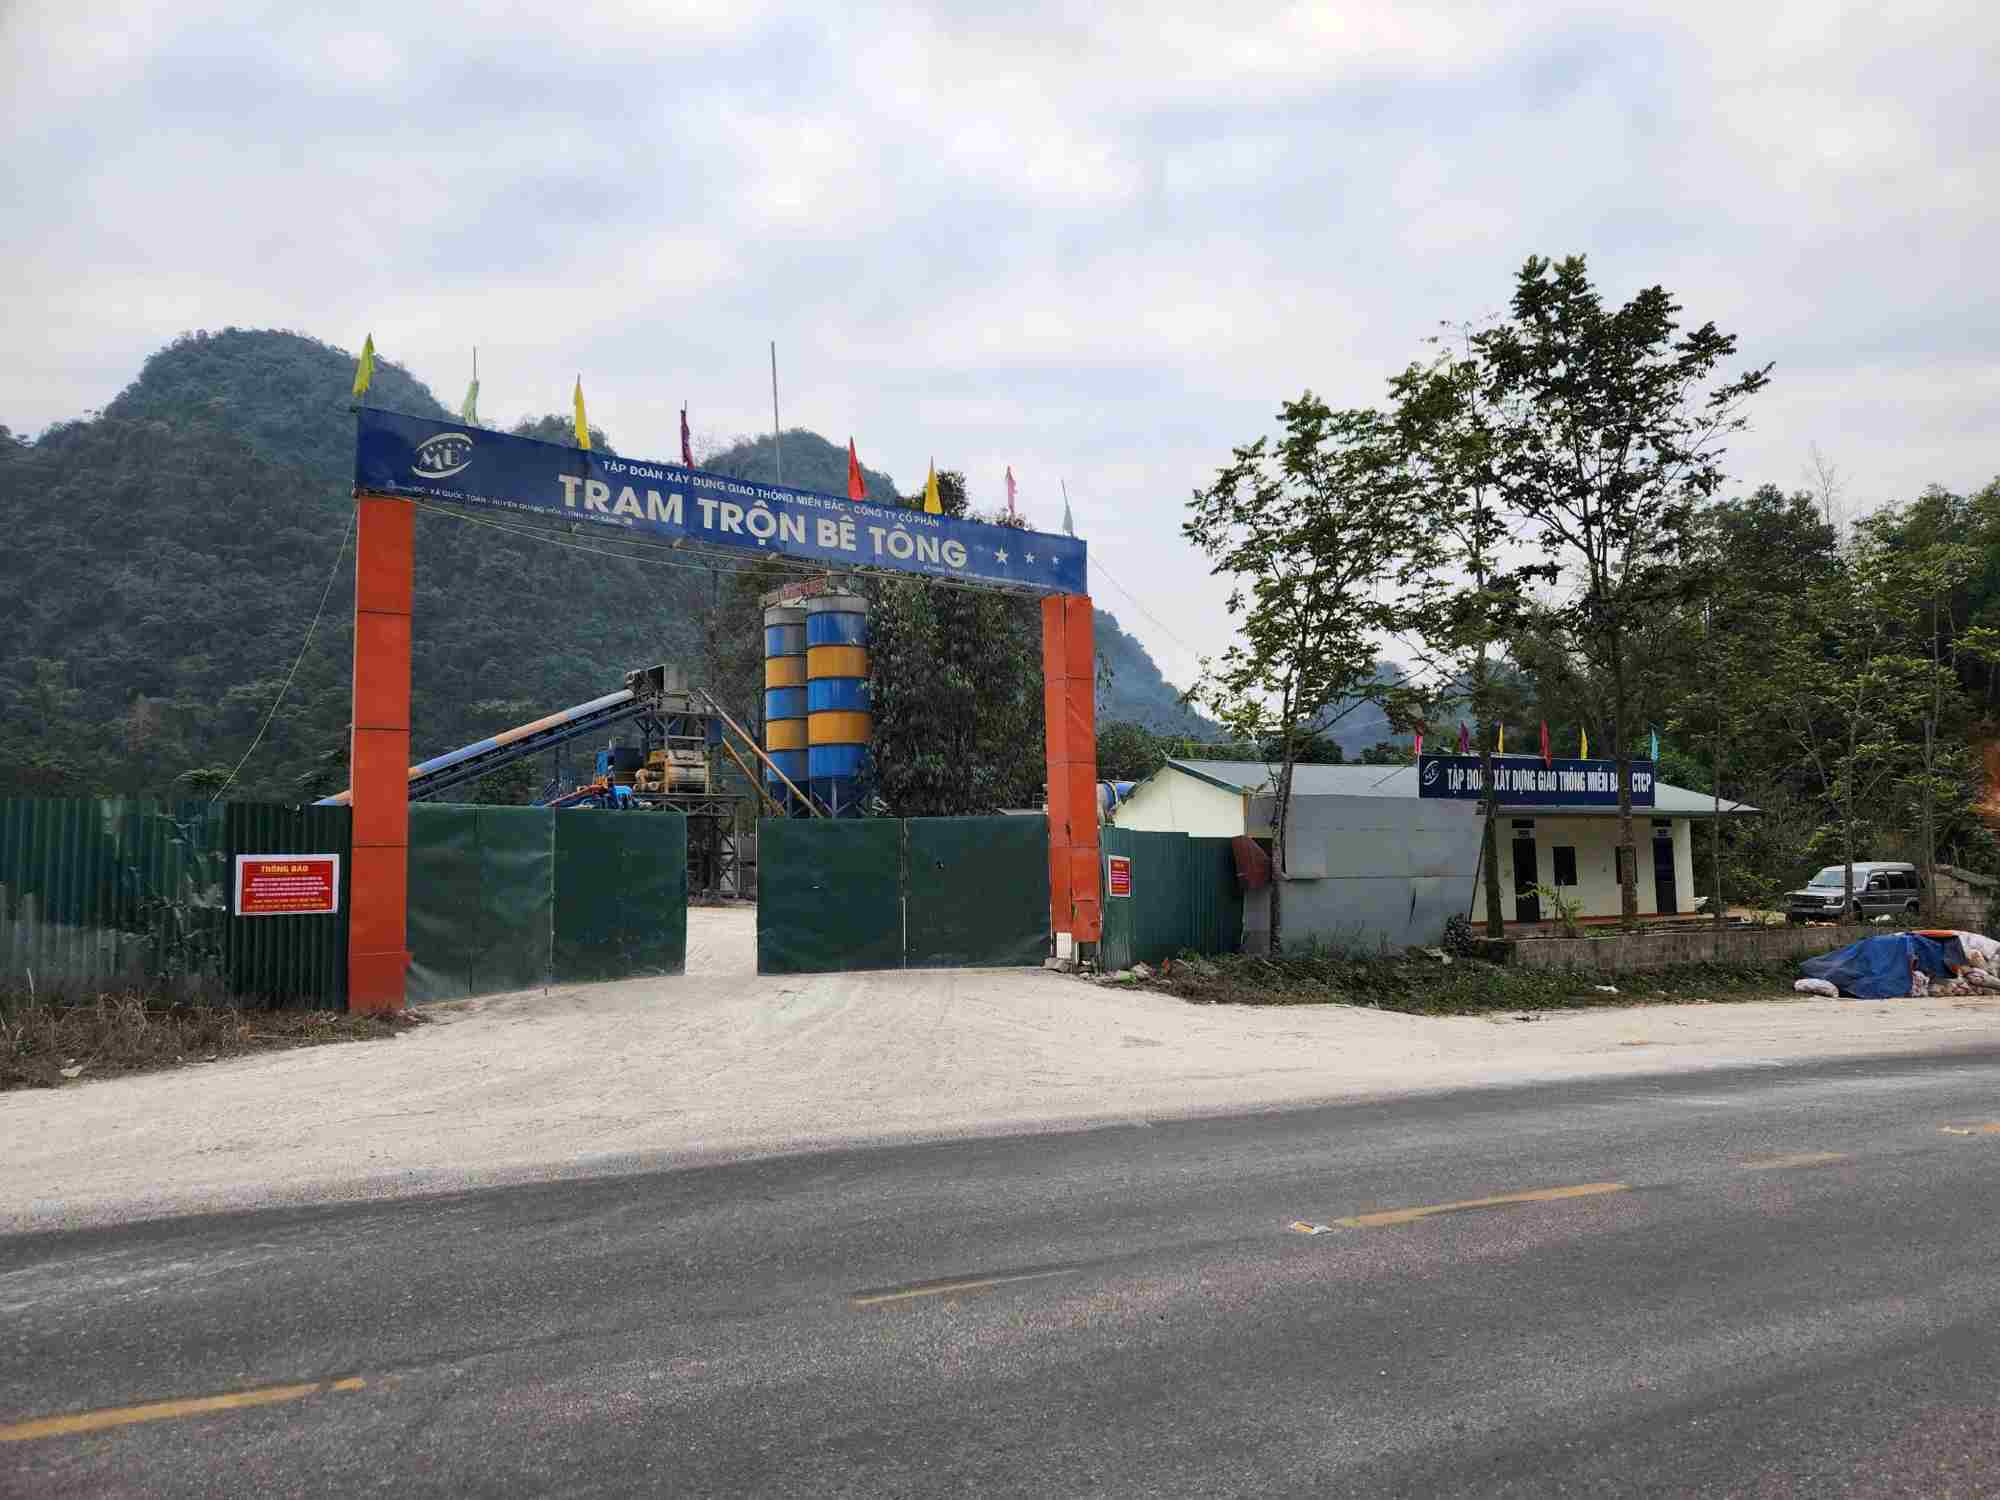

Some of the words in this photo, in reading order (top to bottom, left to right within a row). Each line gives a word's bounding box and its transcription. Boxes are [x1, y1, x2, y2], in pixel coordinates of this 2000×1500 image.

[727, 484, 754, 496] GIAO
[884, 510, 897, 519] TY
[557, 473, 683, 526] TRẠM
[697, 498, 806, 545] TRỘN
[816, 514, 857, 552] BÊ
[868, 522, 967, 568] TÔNG
[1447, 764, 1465, 794] TẬP
[1494, 764, 1510, 791] XÂY
[1513, 768, 1536, 794] DỰNG
[1538, 770, 1557, 792] GIAO
[1559, 766, 1586, 792] THÔNG
[1632, 772, 1651, 793] CTCP
